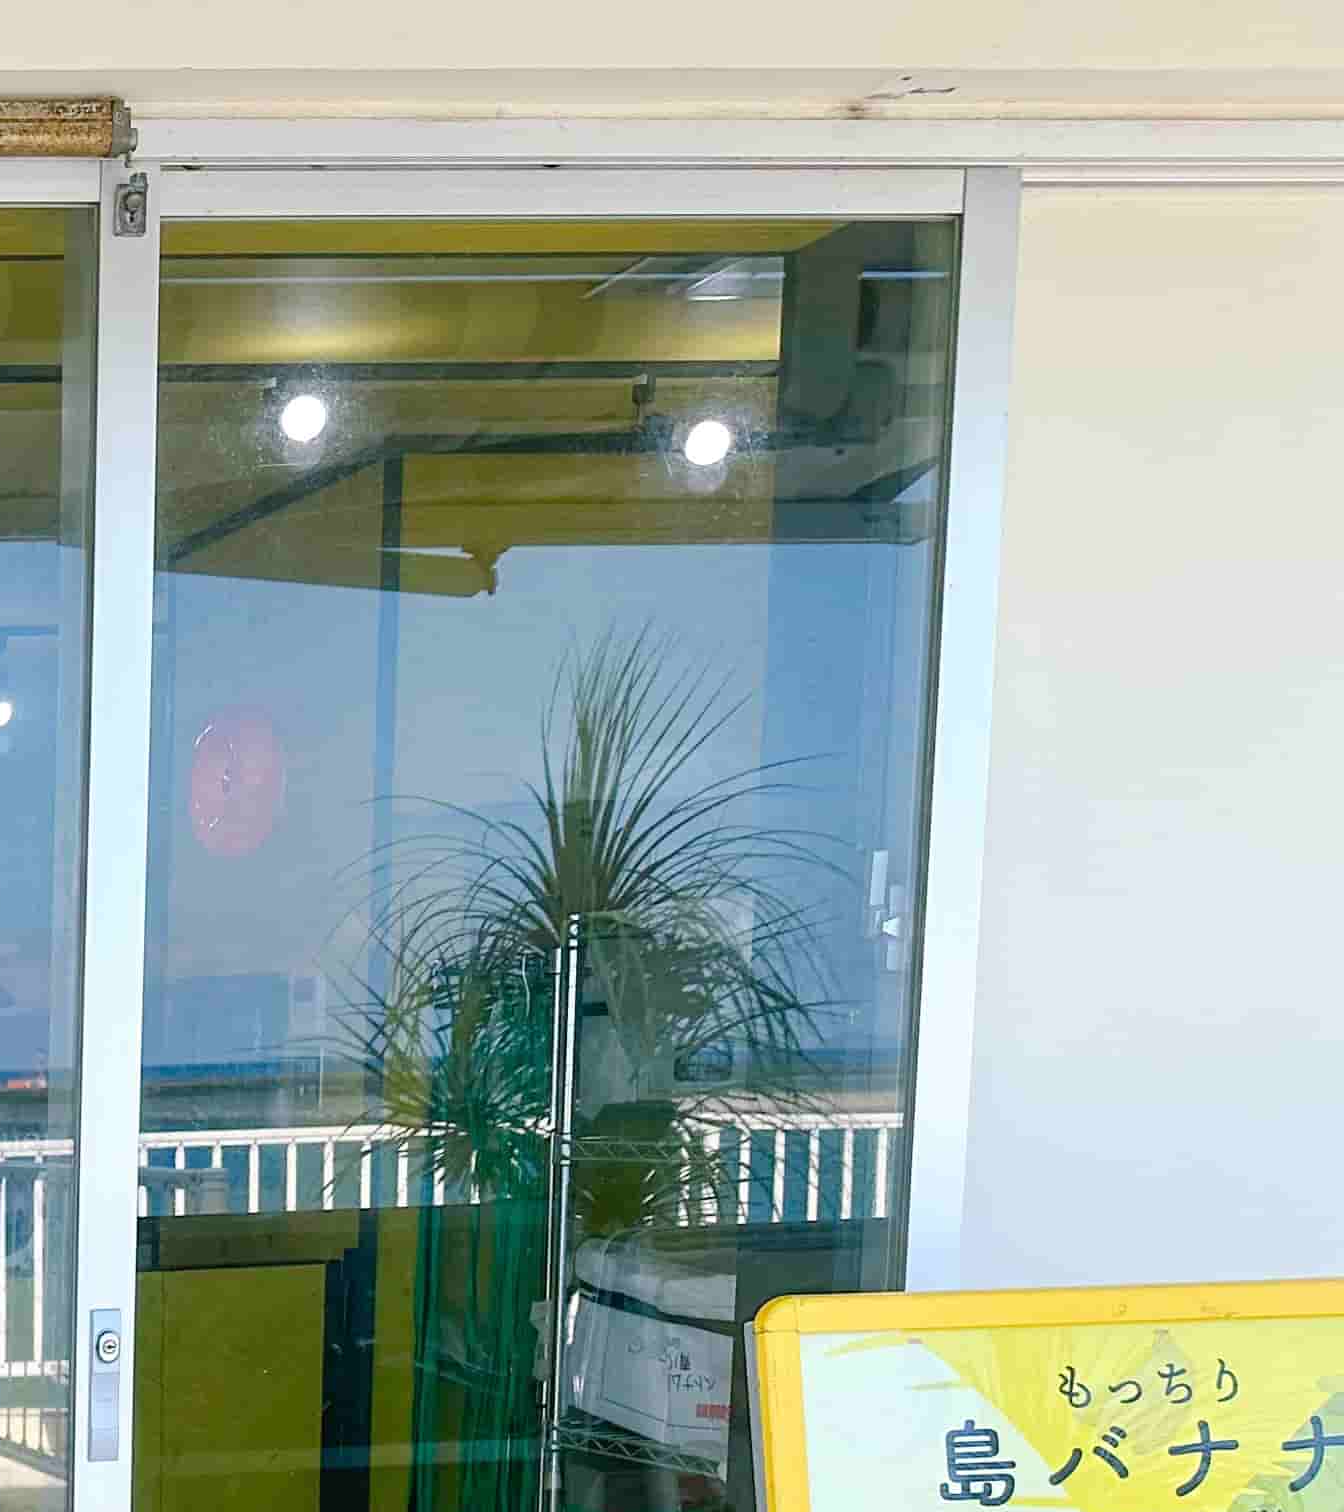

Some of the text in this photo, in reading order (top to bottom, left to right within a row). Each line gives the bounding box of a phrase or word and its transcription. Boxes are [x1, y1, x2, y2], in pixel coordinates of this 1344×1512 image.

[1057, 1357, 1239, 1408] もっちり
[939, 1413, 1344, 1507] 島バナナ
